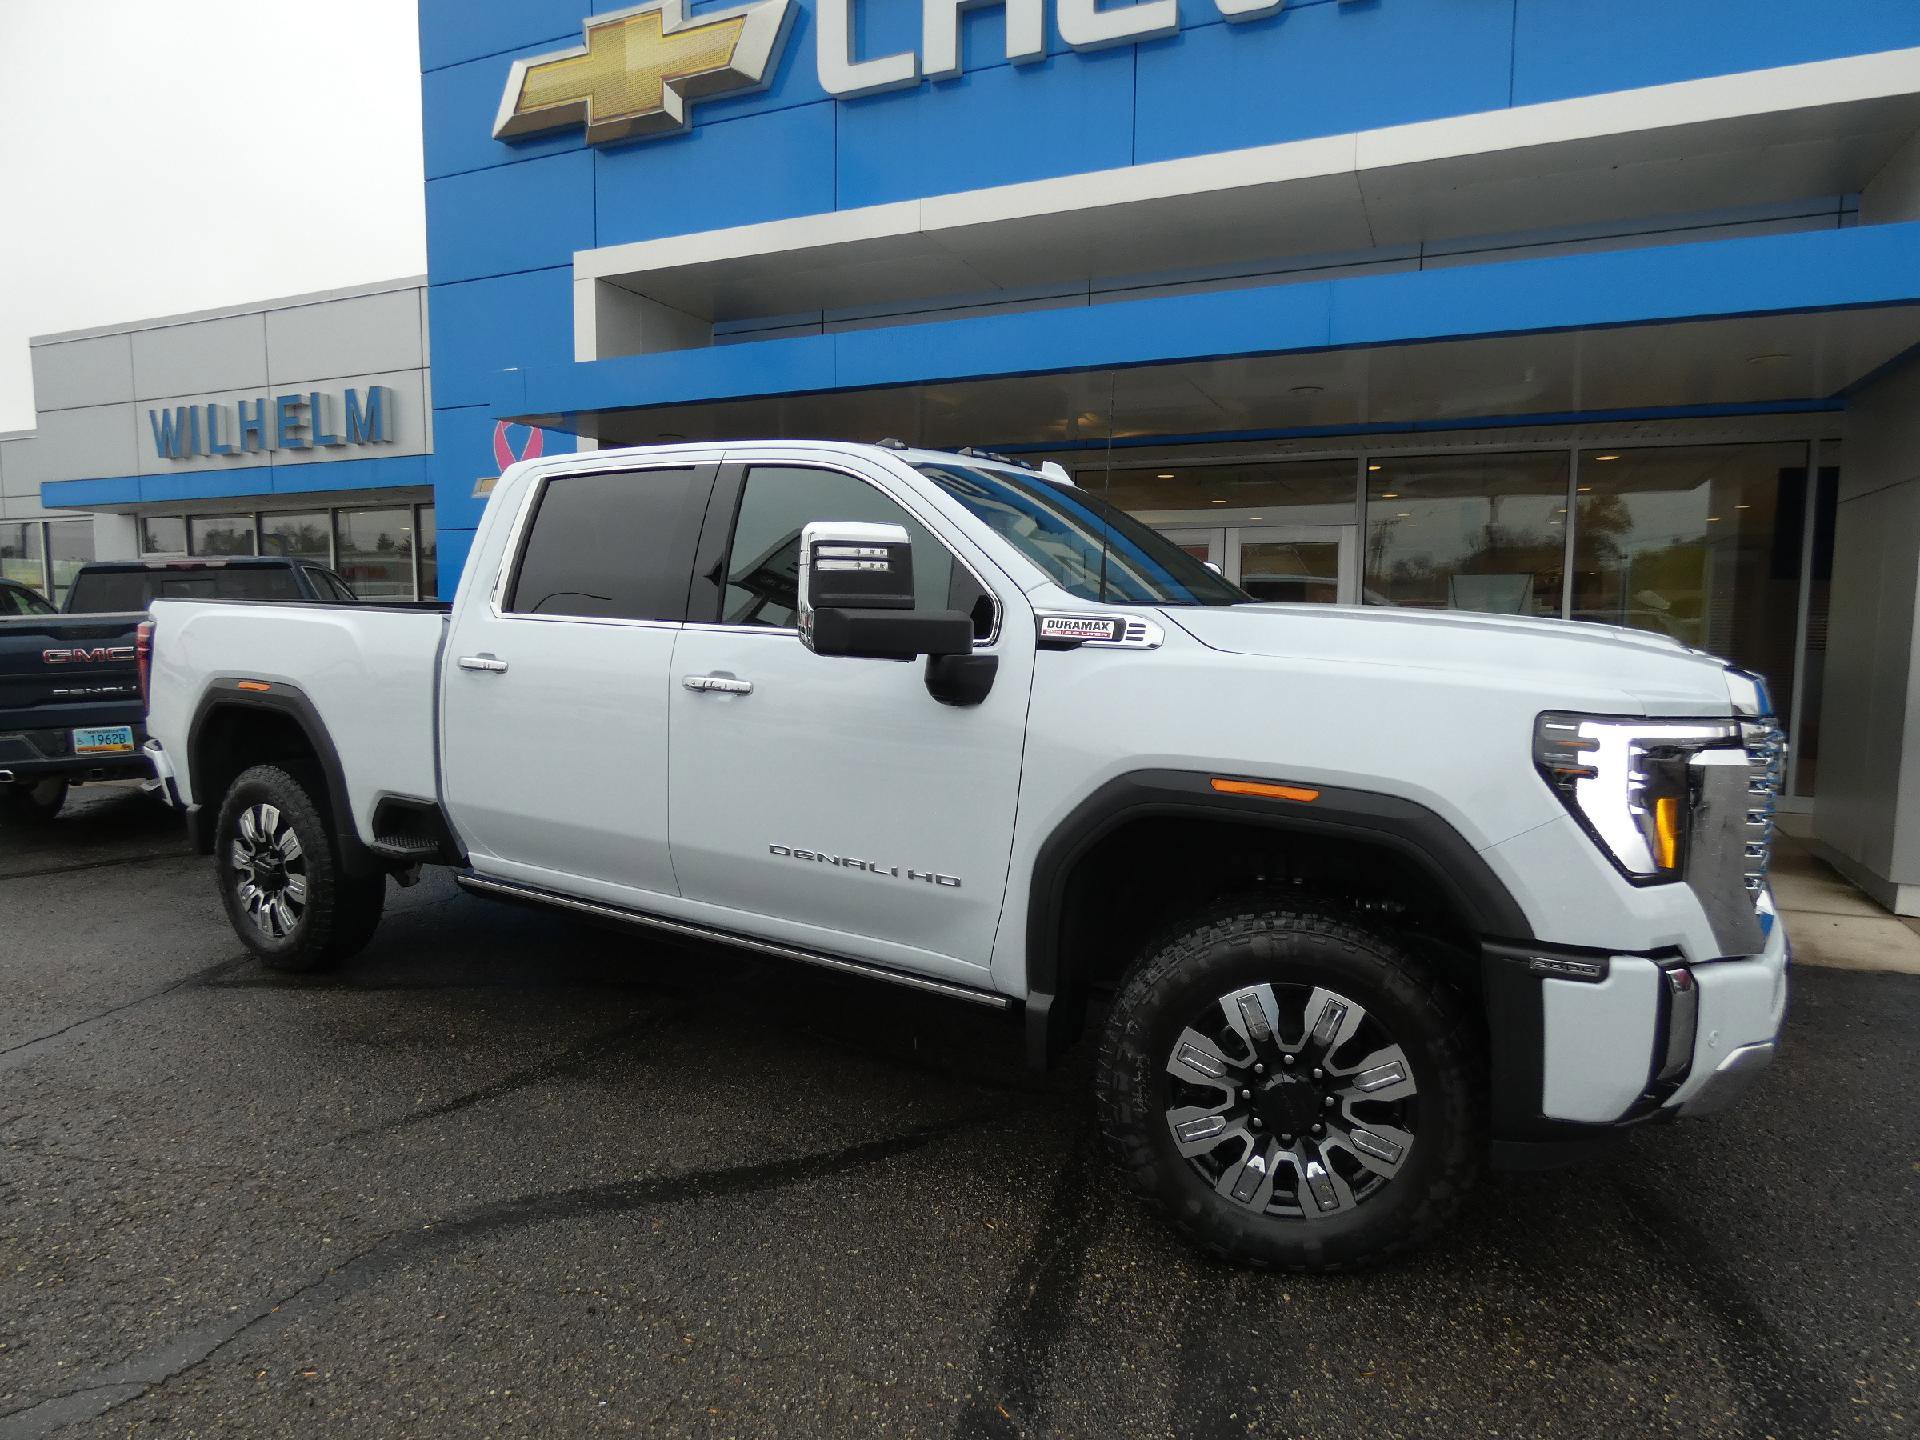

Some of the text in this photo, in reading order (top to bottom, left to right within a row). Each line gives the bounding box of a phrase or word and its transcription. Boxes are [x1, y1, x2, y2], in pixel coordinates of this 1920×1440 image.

[149, 385, 391, 460] WILHELM
[1046, 619, 1111, 631] DURAMAX
[42, 646, 135, 664] GMC
[769, 842, 962, 887] DENALI HD
